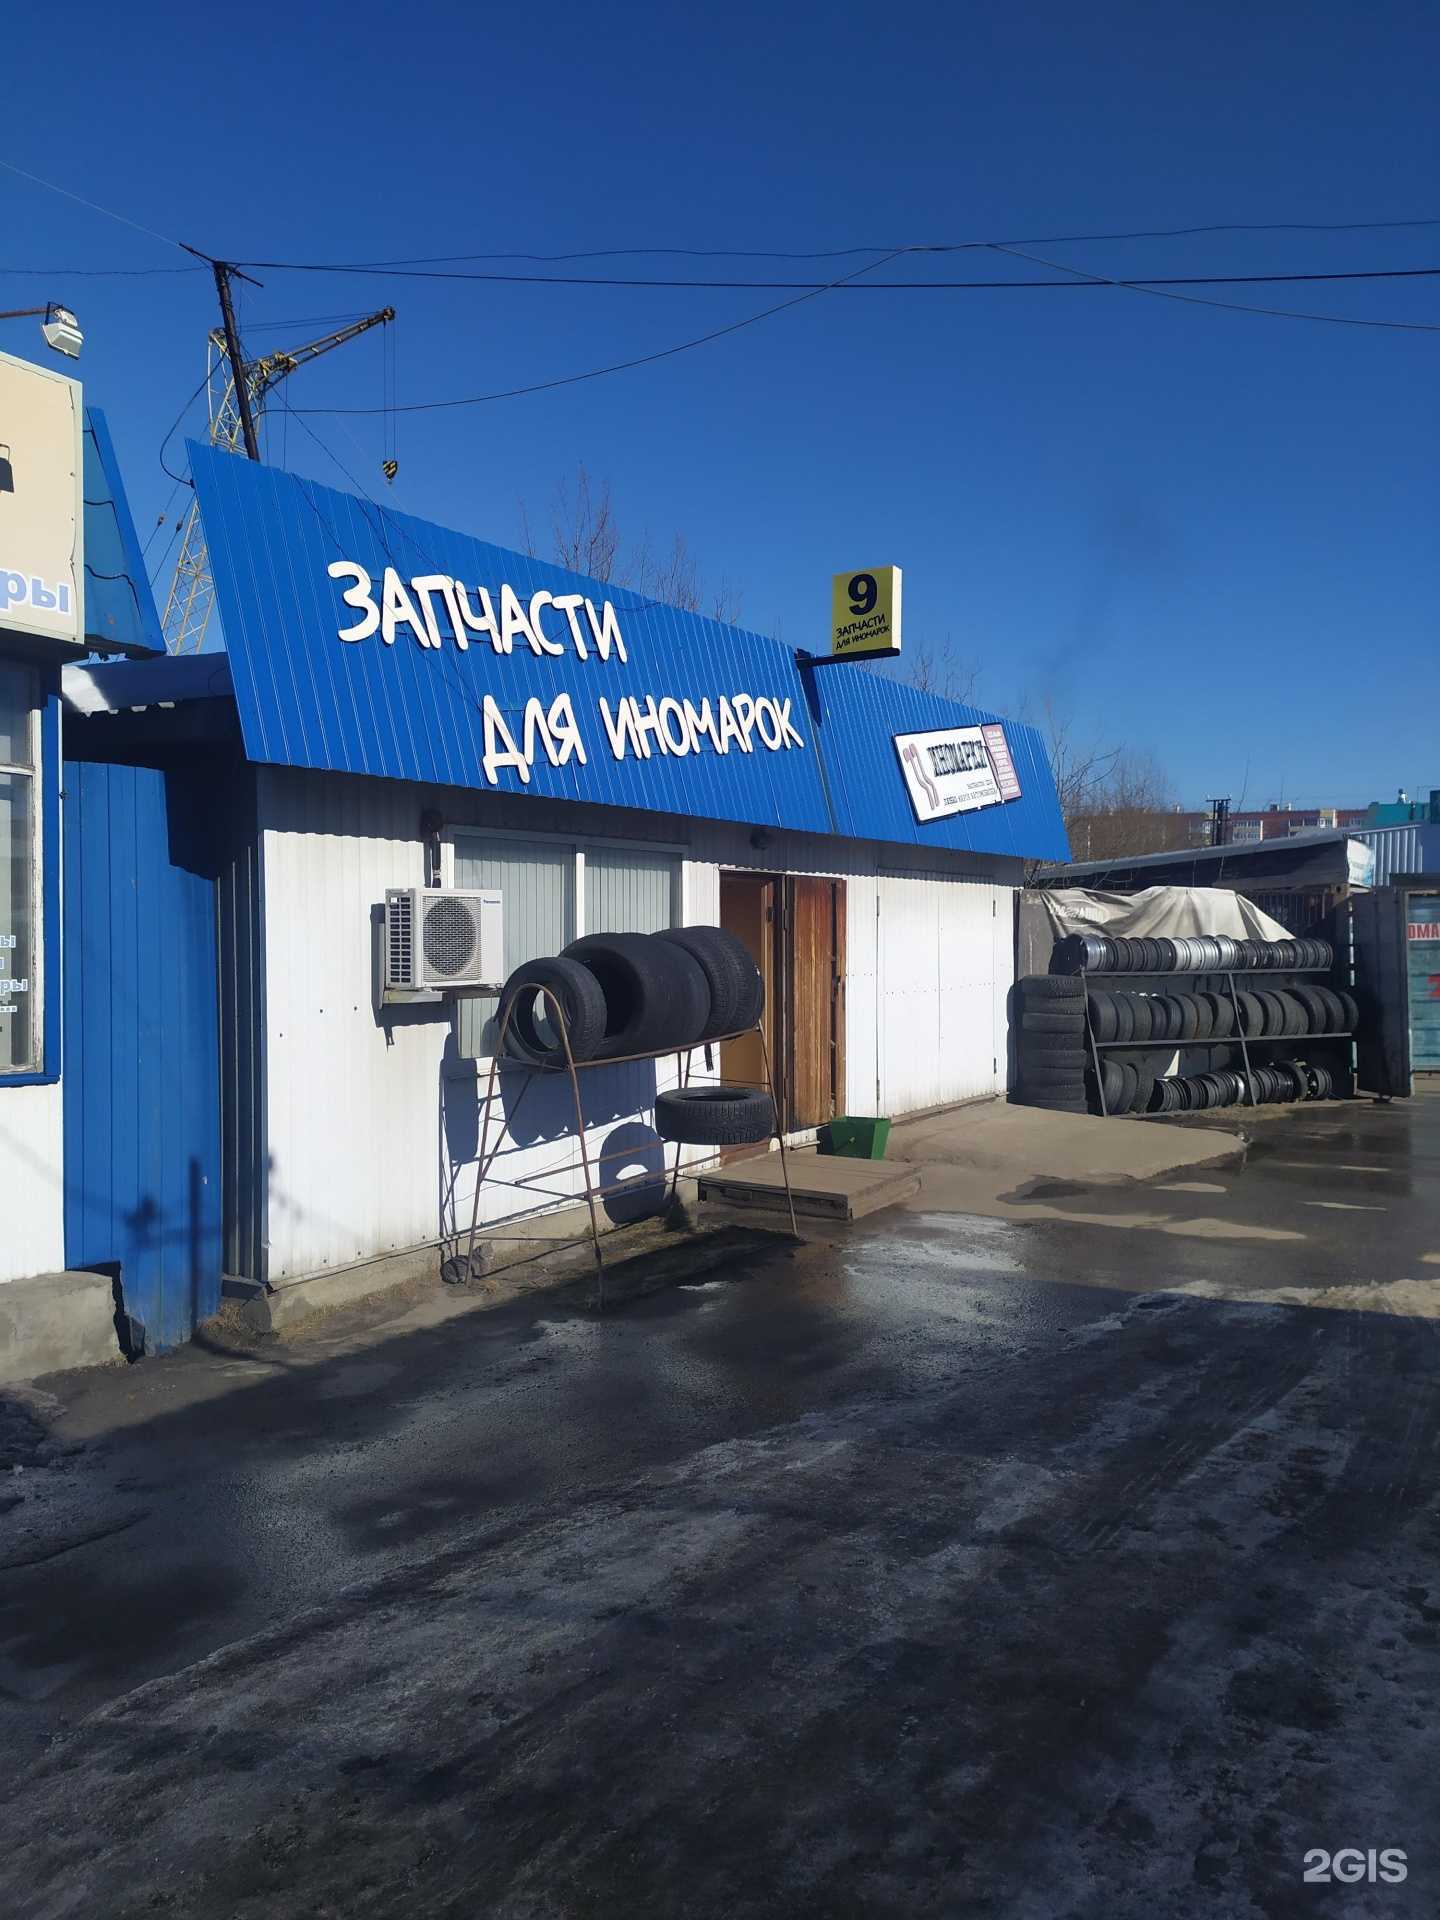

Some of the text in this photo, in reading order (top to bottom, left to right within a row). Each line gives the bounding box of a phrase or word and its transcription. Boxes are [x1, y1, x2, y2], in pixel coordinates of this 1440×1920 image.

[327, 561, 628, 663] ЗАПЧАСТИ
[848, 574, 878, 615] 9
[836, 614, 886, 639] ЗАПЧАСТИ
[836, 625, 890, 650] ДЛЯ ИНОМАРОК
[482, 692, 804, 785] ДЛЯ ИНОМАРОК
